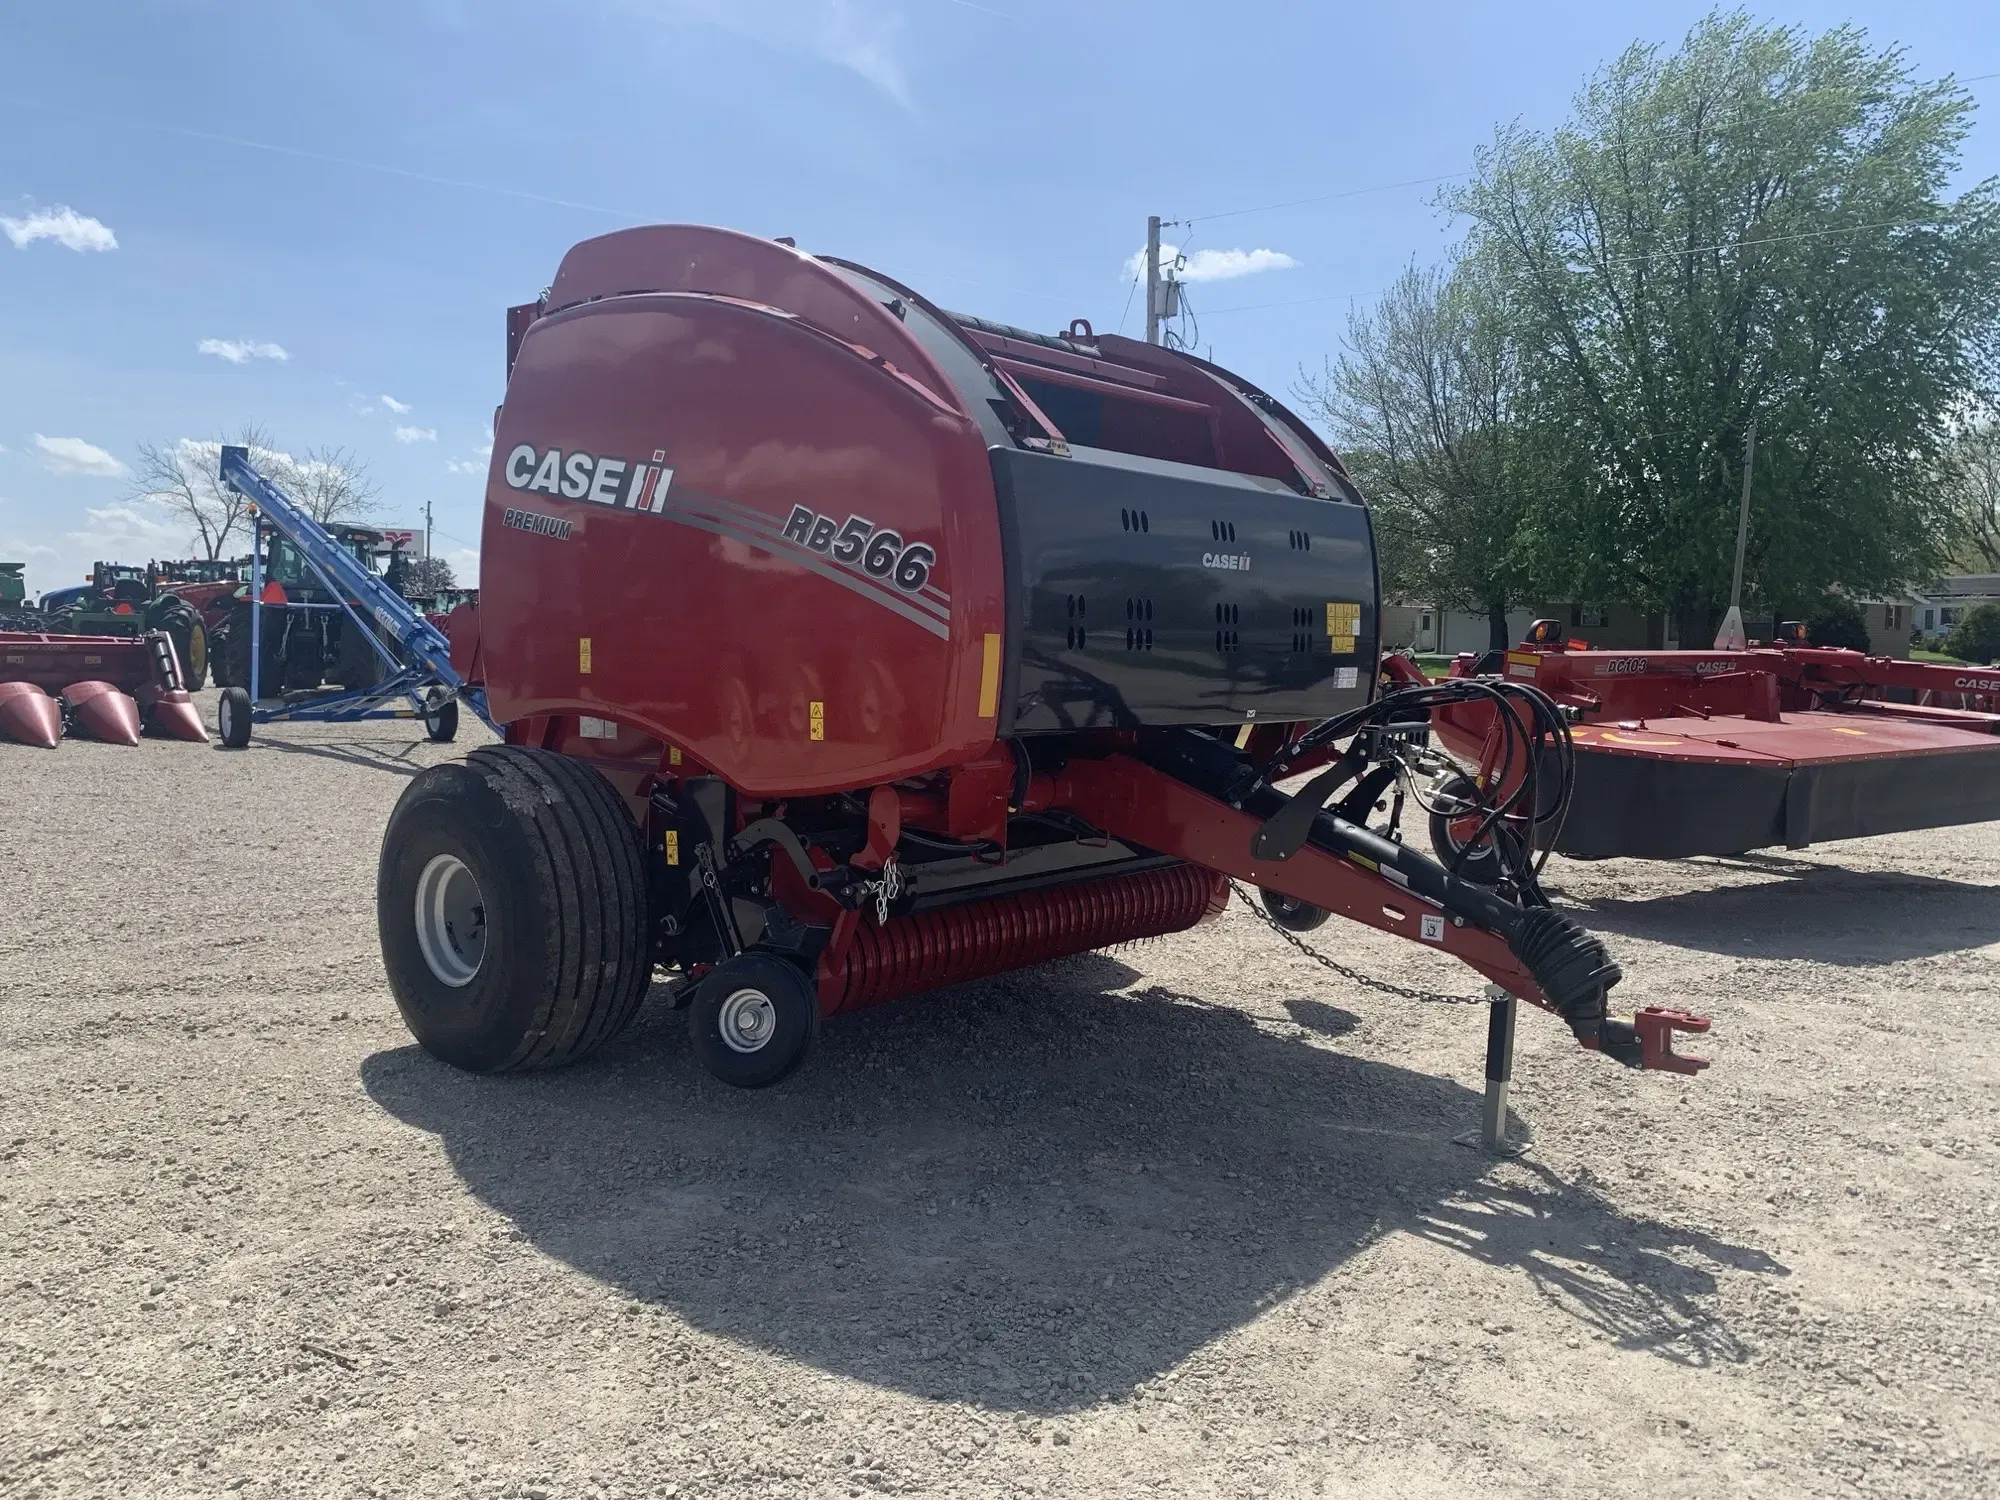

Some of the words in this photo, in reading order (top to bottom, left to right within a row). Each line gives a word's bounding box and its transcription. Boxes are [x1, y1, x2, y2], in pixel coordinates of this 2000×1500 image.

[505, 444, 626, 505] CASE
[503, 507, 573, 541] PREMIUM
[781, 503, 936, 593] RB566
[1202, 552, 1238, 570] CASE
[1607, 657, 1648, 674] DC103
[1696, 661, 1727, 674] CASE
[1954, 677, 2000, 690] CASE
